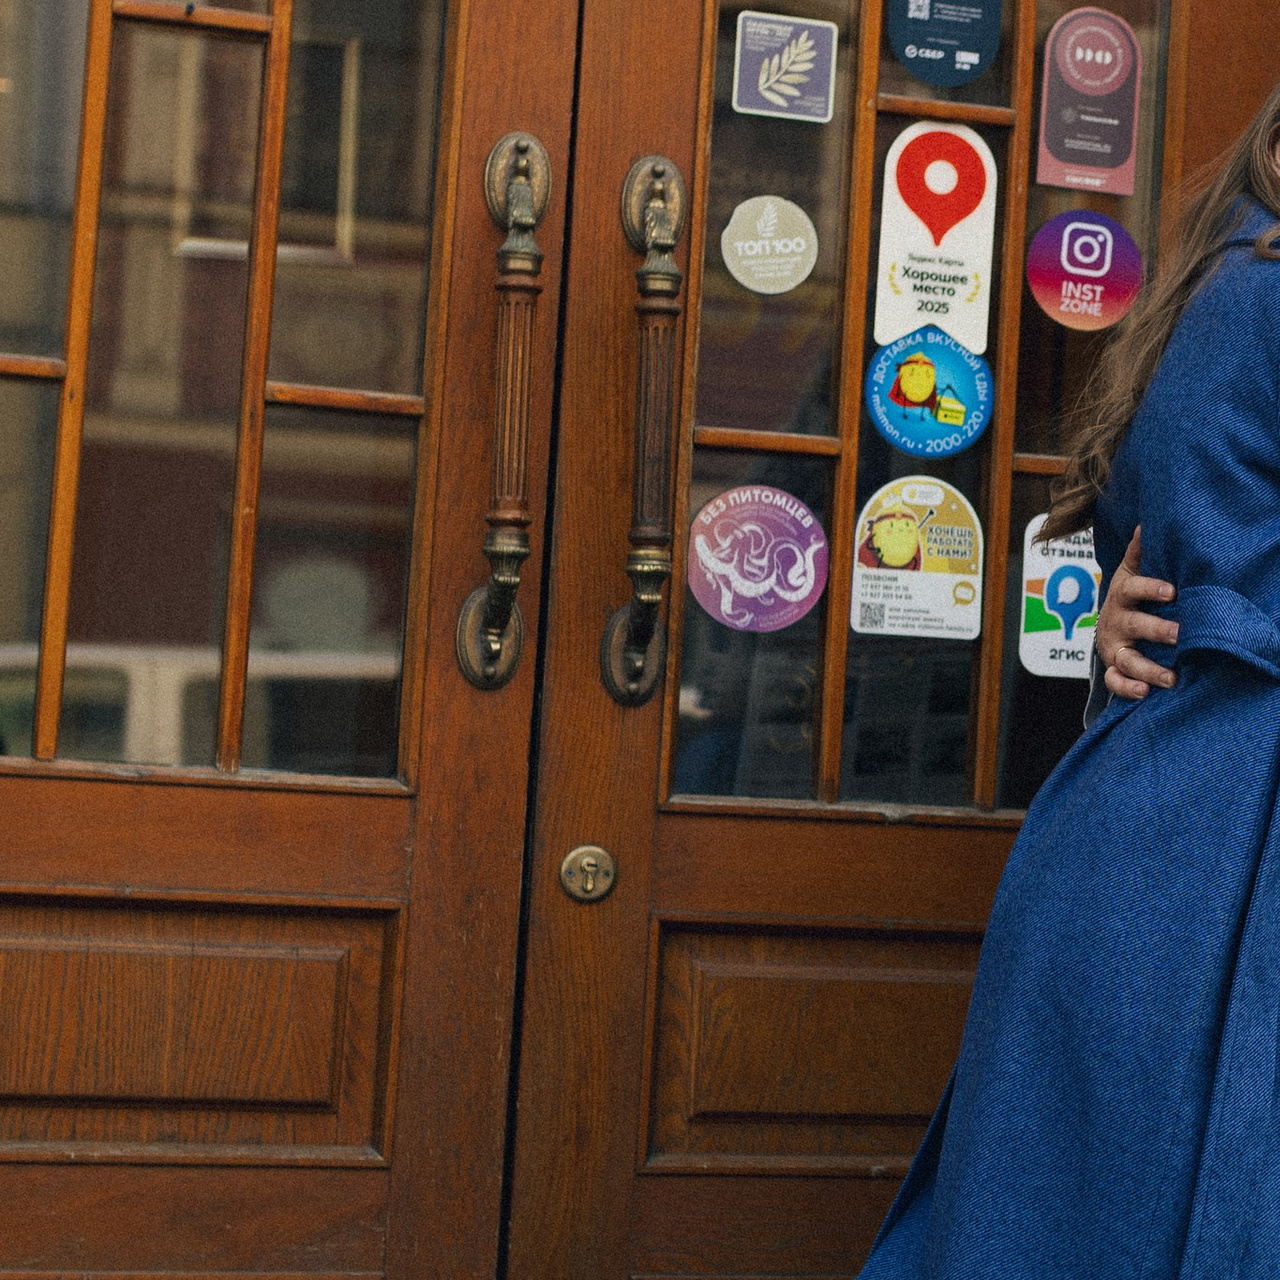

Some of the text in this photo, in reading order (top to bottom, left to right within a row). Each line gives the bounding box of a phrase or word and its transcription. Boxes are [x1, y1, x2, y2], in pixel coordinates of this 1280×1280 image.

[734, 236, 806, 256] ТОП 100
[902, 266, 969, 285] Хорошее
[912, 283, 956, 297] место
[1061, 280, 1105, 302] INST
[916, 299, 949, 314] 2025
[1060, 297, 1102, 317] ZONE
[873, 331, 988, 402] ДОСТАВКА ВКУСНОЙ ЕДЫ
[925, 411, 984, 453] 2000-220
[699, 498, 727, 526] БЕЗ
[727, 488, 814, 529] ПИТОМЦЕВ
[926, 536, 974, 548] РАБОТАТЬ
[927, 526, 974, 539] ХОЧЕШЬ
[927, 547, 973, 559] С НАМИ?
[1049, 648, 1086, 662] 2ГИС
